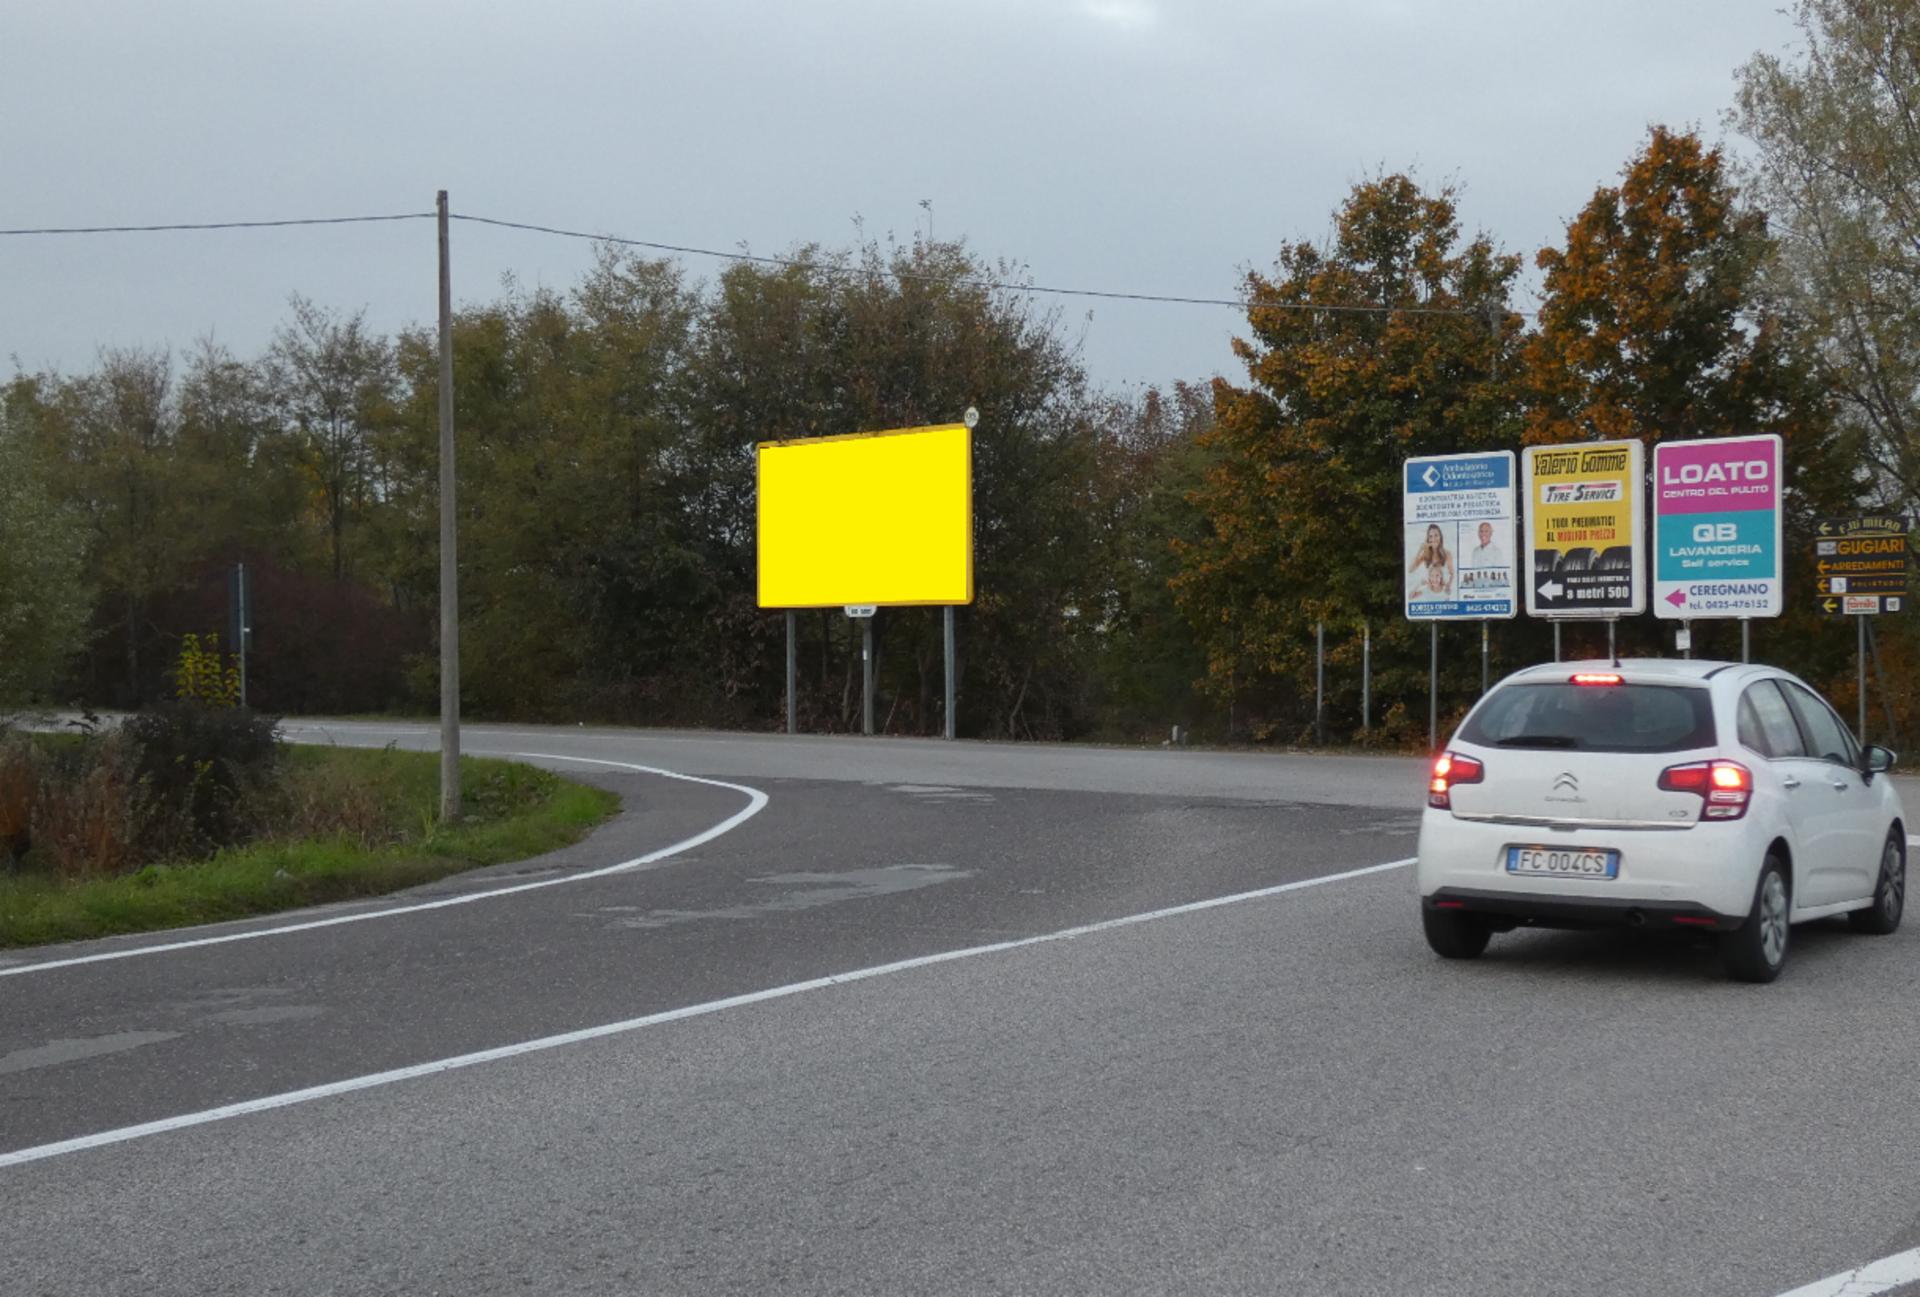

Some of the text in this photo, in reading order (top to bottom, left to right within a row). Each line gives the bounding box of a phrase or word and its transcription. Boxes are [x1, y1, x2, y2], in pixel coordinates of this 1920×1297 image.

[1581, 449, 1628, 473] Gomme
[1663, 460, 1768, 485] LOATO
[1663, 484, 1769, 498] CENTRO DEL PULITO
[1693, 523, 1737, 542] QB
[1669, 544, 1762, 556] LAVANDERIA
[1838, 539, 1904, 555] GUGIARI
[1682, 559, 1750, 568] Self service
[1831, 560, 1904, 570] ARREDAMENTI
[1576, 587, 1604, 599] metri
[1607, 586, 1629, 598] 500
[1689, 583, 1768, 596] CEREGNANO
[1705, 600, 1768, 609] 0425-476152
[1521, 851, 1604, 873] FC 004CS
